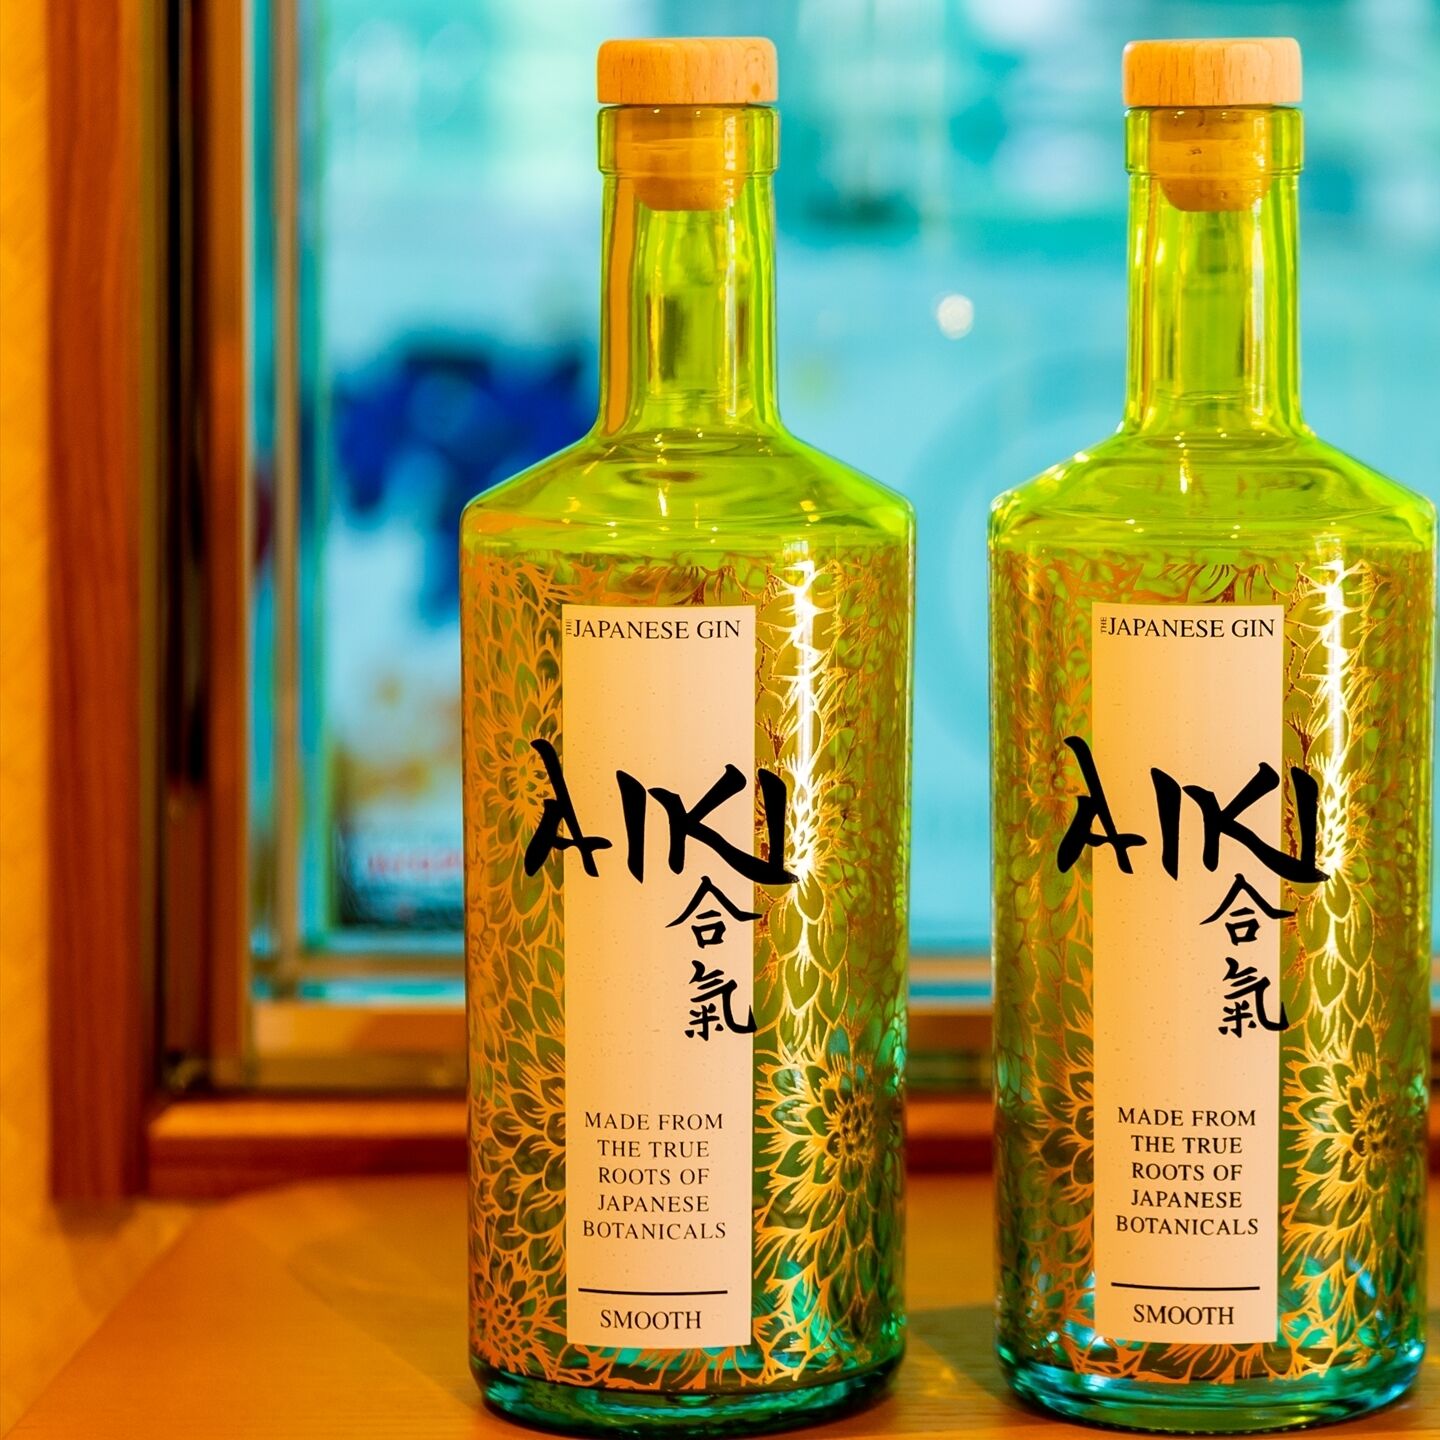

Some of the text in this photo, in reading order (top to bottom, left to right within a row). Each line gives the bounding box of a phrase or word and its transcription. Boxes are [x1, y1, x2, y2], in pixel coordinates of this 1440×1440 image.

[574, 620, 689, 639] JAPANESE
[697, 620, 741, 639] GIN
[1108, 617, 1224, 637] JAPANESE
[1232, 619, 1274, 637] GIN
[524, 739, 800, 884] AIKI
[1057, 736, 1330, 883] AIKI
[585, 1112, 723, 1130] MADE FROM
[1118, 1107, 1255, 1127] MADE FROM
[597, 1140, 709, 1158] THE TRUE
[1131, 1135, 1242, 1154] THE TRUE
[599, 1167, 709, 1185] ROOTS OF
[1132, 1163, 1242, 1181] ROOTS OF
[598, 1195, 709, 1212] JAPANESE
[1131, 1190, 1242, 1208] JAPANESE
[583, 1221, 725, 1240] BOTANICALS
[1116, 1216, 1258, 1235] BOTANICALS
[600, 1310, 702, 1329] SMOOTH
[1133, 1304, 1234, 1325] SMOOTH
